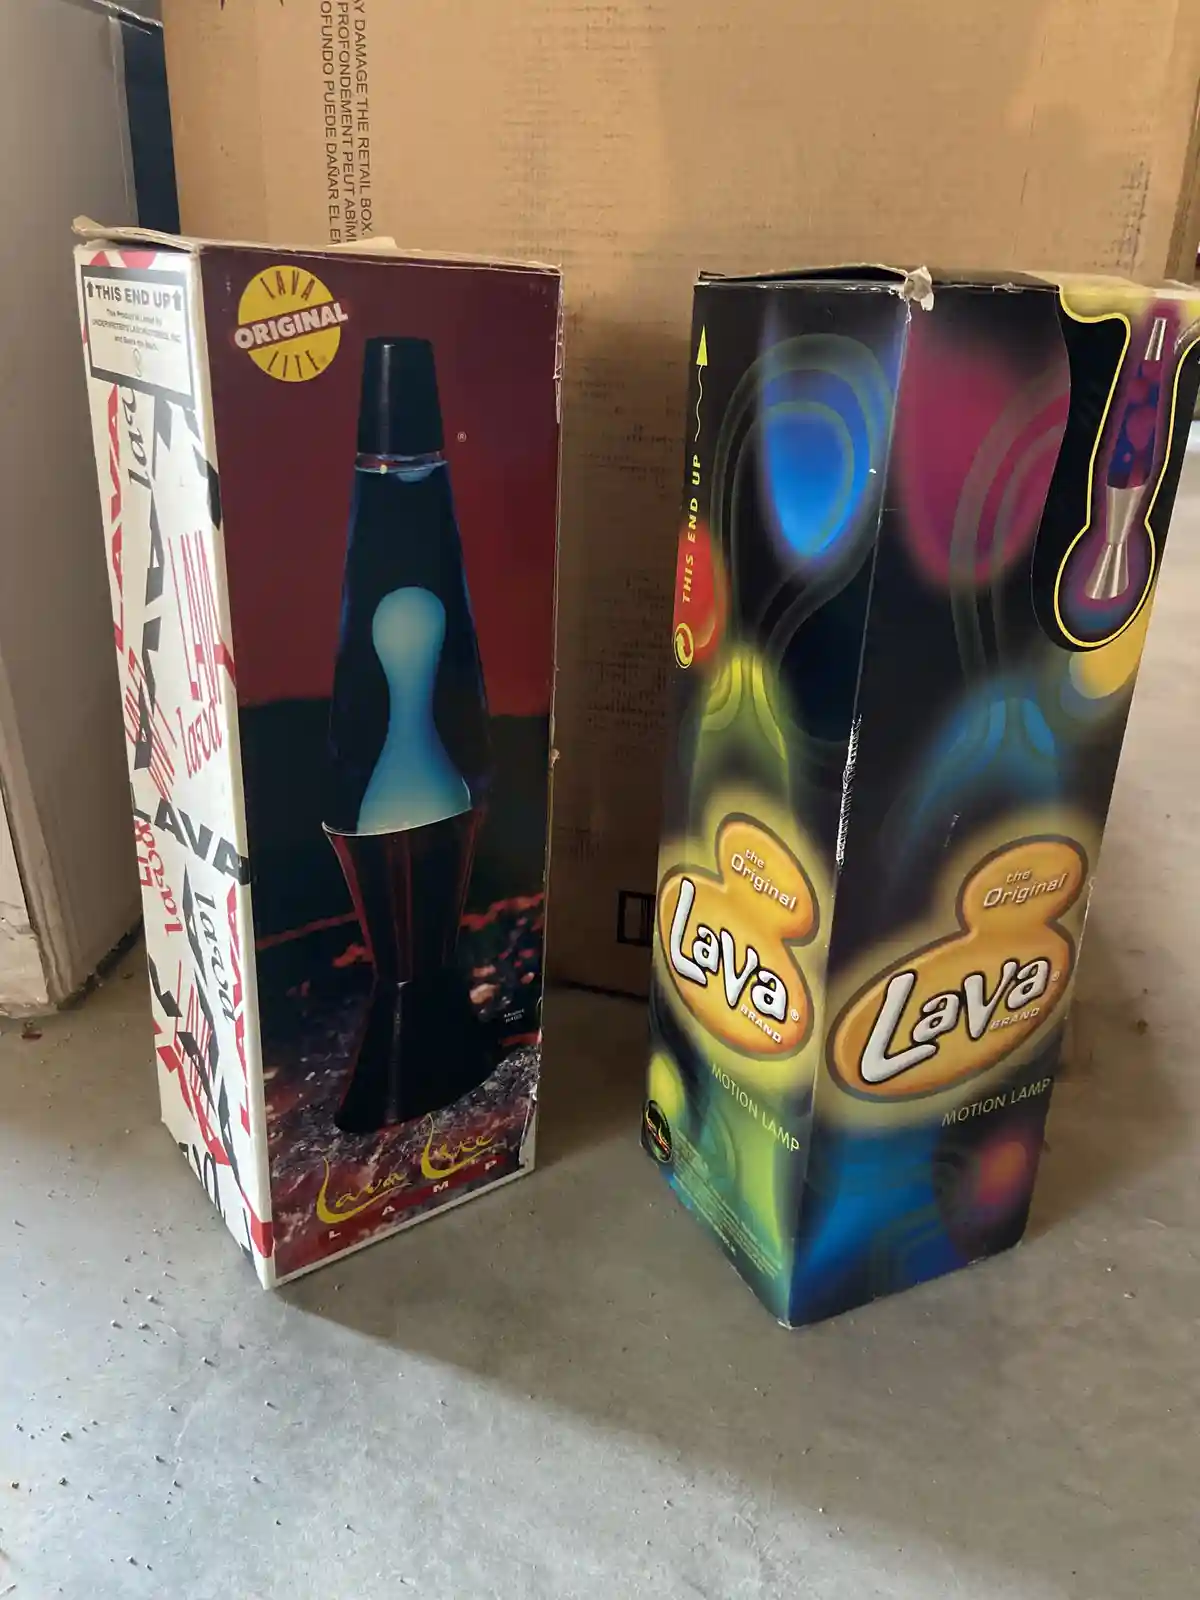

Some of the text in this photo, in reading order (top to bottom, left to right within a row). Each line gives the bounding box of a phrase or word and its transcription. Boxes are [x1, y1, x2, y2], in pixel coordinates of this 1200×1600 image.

[354, 19, 368, 94] DAMAGE
[323, 80, 337, 138] PUEDE
[337, 2, 358, 242] PROFONDEMENT PEUT ABÎM
[356, 98, 370, 133] THE
[326, 142, 341, 200] DAÑAR
[358, 136, 371, 195] RETAIL
[328, 205, 340, 227] EL
[360, 197, 373, 236] BOX.
[95, 284, 171, 309] THIS END UP
[260, 270, 315, 301] LAVA
[234, 302, 349, 349] ORIGINAL
[266, 350, 320, 378] LITE
[681, 453, 702, 603] THIS END UP
[744, 848, 765, 869] the
[1006, 868, 1031, 884] the
[731, 853, 798, 911] Original
[982, 871, 1069, 908] Original
[740, 1004, 783, 1044] BRAND
[989, 1006, 1041, 1031] BRAND
[711, 1062, 800, 1152] MOTION LAMP
[941, 1077, 1052, 1128] MOTION LAMP
